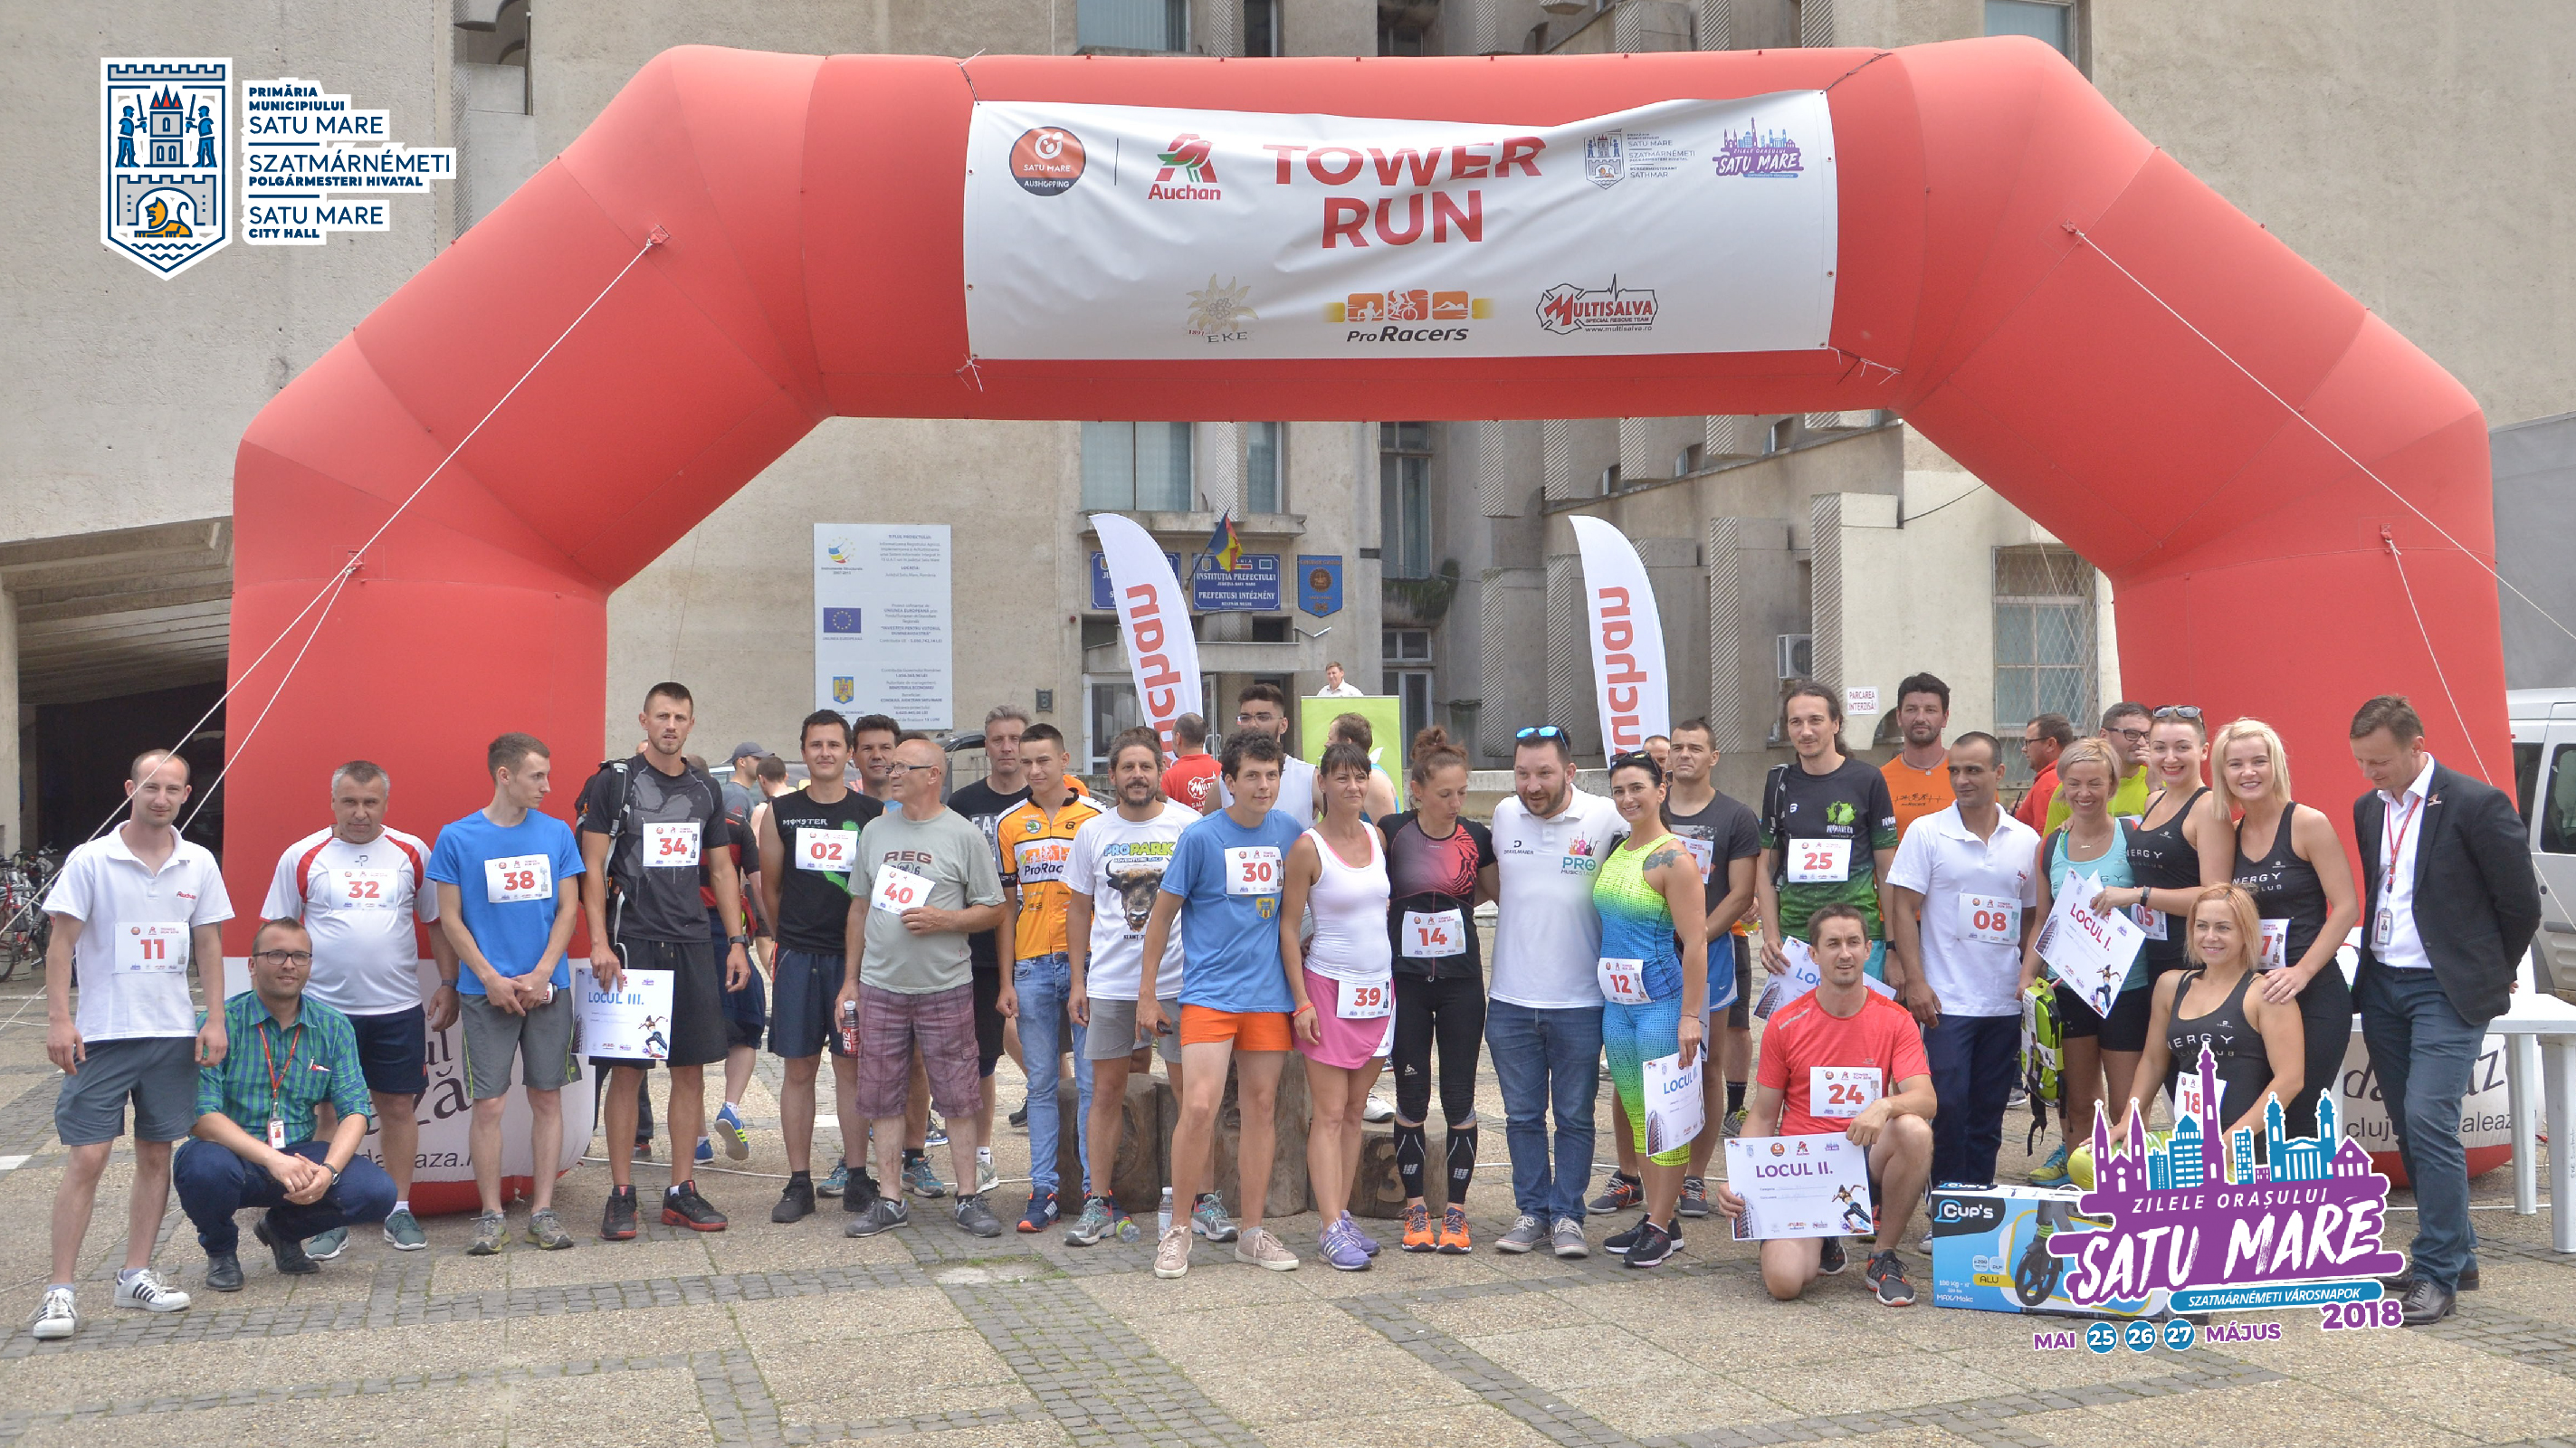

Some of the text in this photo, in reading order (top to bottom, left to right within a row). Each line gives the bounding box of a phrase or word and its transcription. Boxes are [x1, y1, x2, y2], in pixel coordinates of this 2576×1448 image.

[1024, 164, 1071, 173] SATU MARE
[1263, 136, 1546, 187] TOWER
[1719, 152, 1798, 174] SATU MARE
[1148, 184, 1221, 201] Auchan
[1322, 189, 1483, 249] RUN
[1544, 292, 1653, 327] MULTISALVA
[1207, 331, 1248, 343] EKE
[1126, 583, 1181, 768] uchan
[1598, 586, 1646, 755] uchan
[782, 818, 828, 826] MONSTER
[659, 838, 688, 856] 34
[811, 842, 842, 860] 02
[1104, 842, 1176, 856] PROPARK
[883, 851, 932, 864] REG
[1562, 856, 1597, 871] PRO
[1804, 853, 1833, 871] 25
[1025, 863, 1064, 876] ProRac
[1242, 862, 1272, 882] 30
[348, 881, 380, 898] 32
[503, 871, 535, 891] 38
[884, 882, 913, 904] 40
[1973, 910, 2007, 932] 08
[2069, 903, 2107, 944] LOCUL
[2136, 905, 2154, 928] 05
[1417, 927, 1448, 947] 14
[2261, 936, 2272, 957] 7
[139, 938, 165, 959] 11
[1609, 974, 1633, 994] 12
[588, 992, 644, 1005] LOCUL III.
[1354, 986, 1381, 1006] 39
[2167, 1034, 2234, 1050] ERGY
[1664, 1073, 1693, 1095] LOCUL
[1828, 1083, 1865, 1105] 24
[2183, 1090, 2201, 1115] 18
[1756, 1161, 1834, 1178] LOCUL II.
[1944, 1204, 1994, 1218] Cup's
